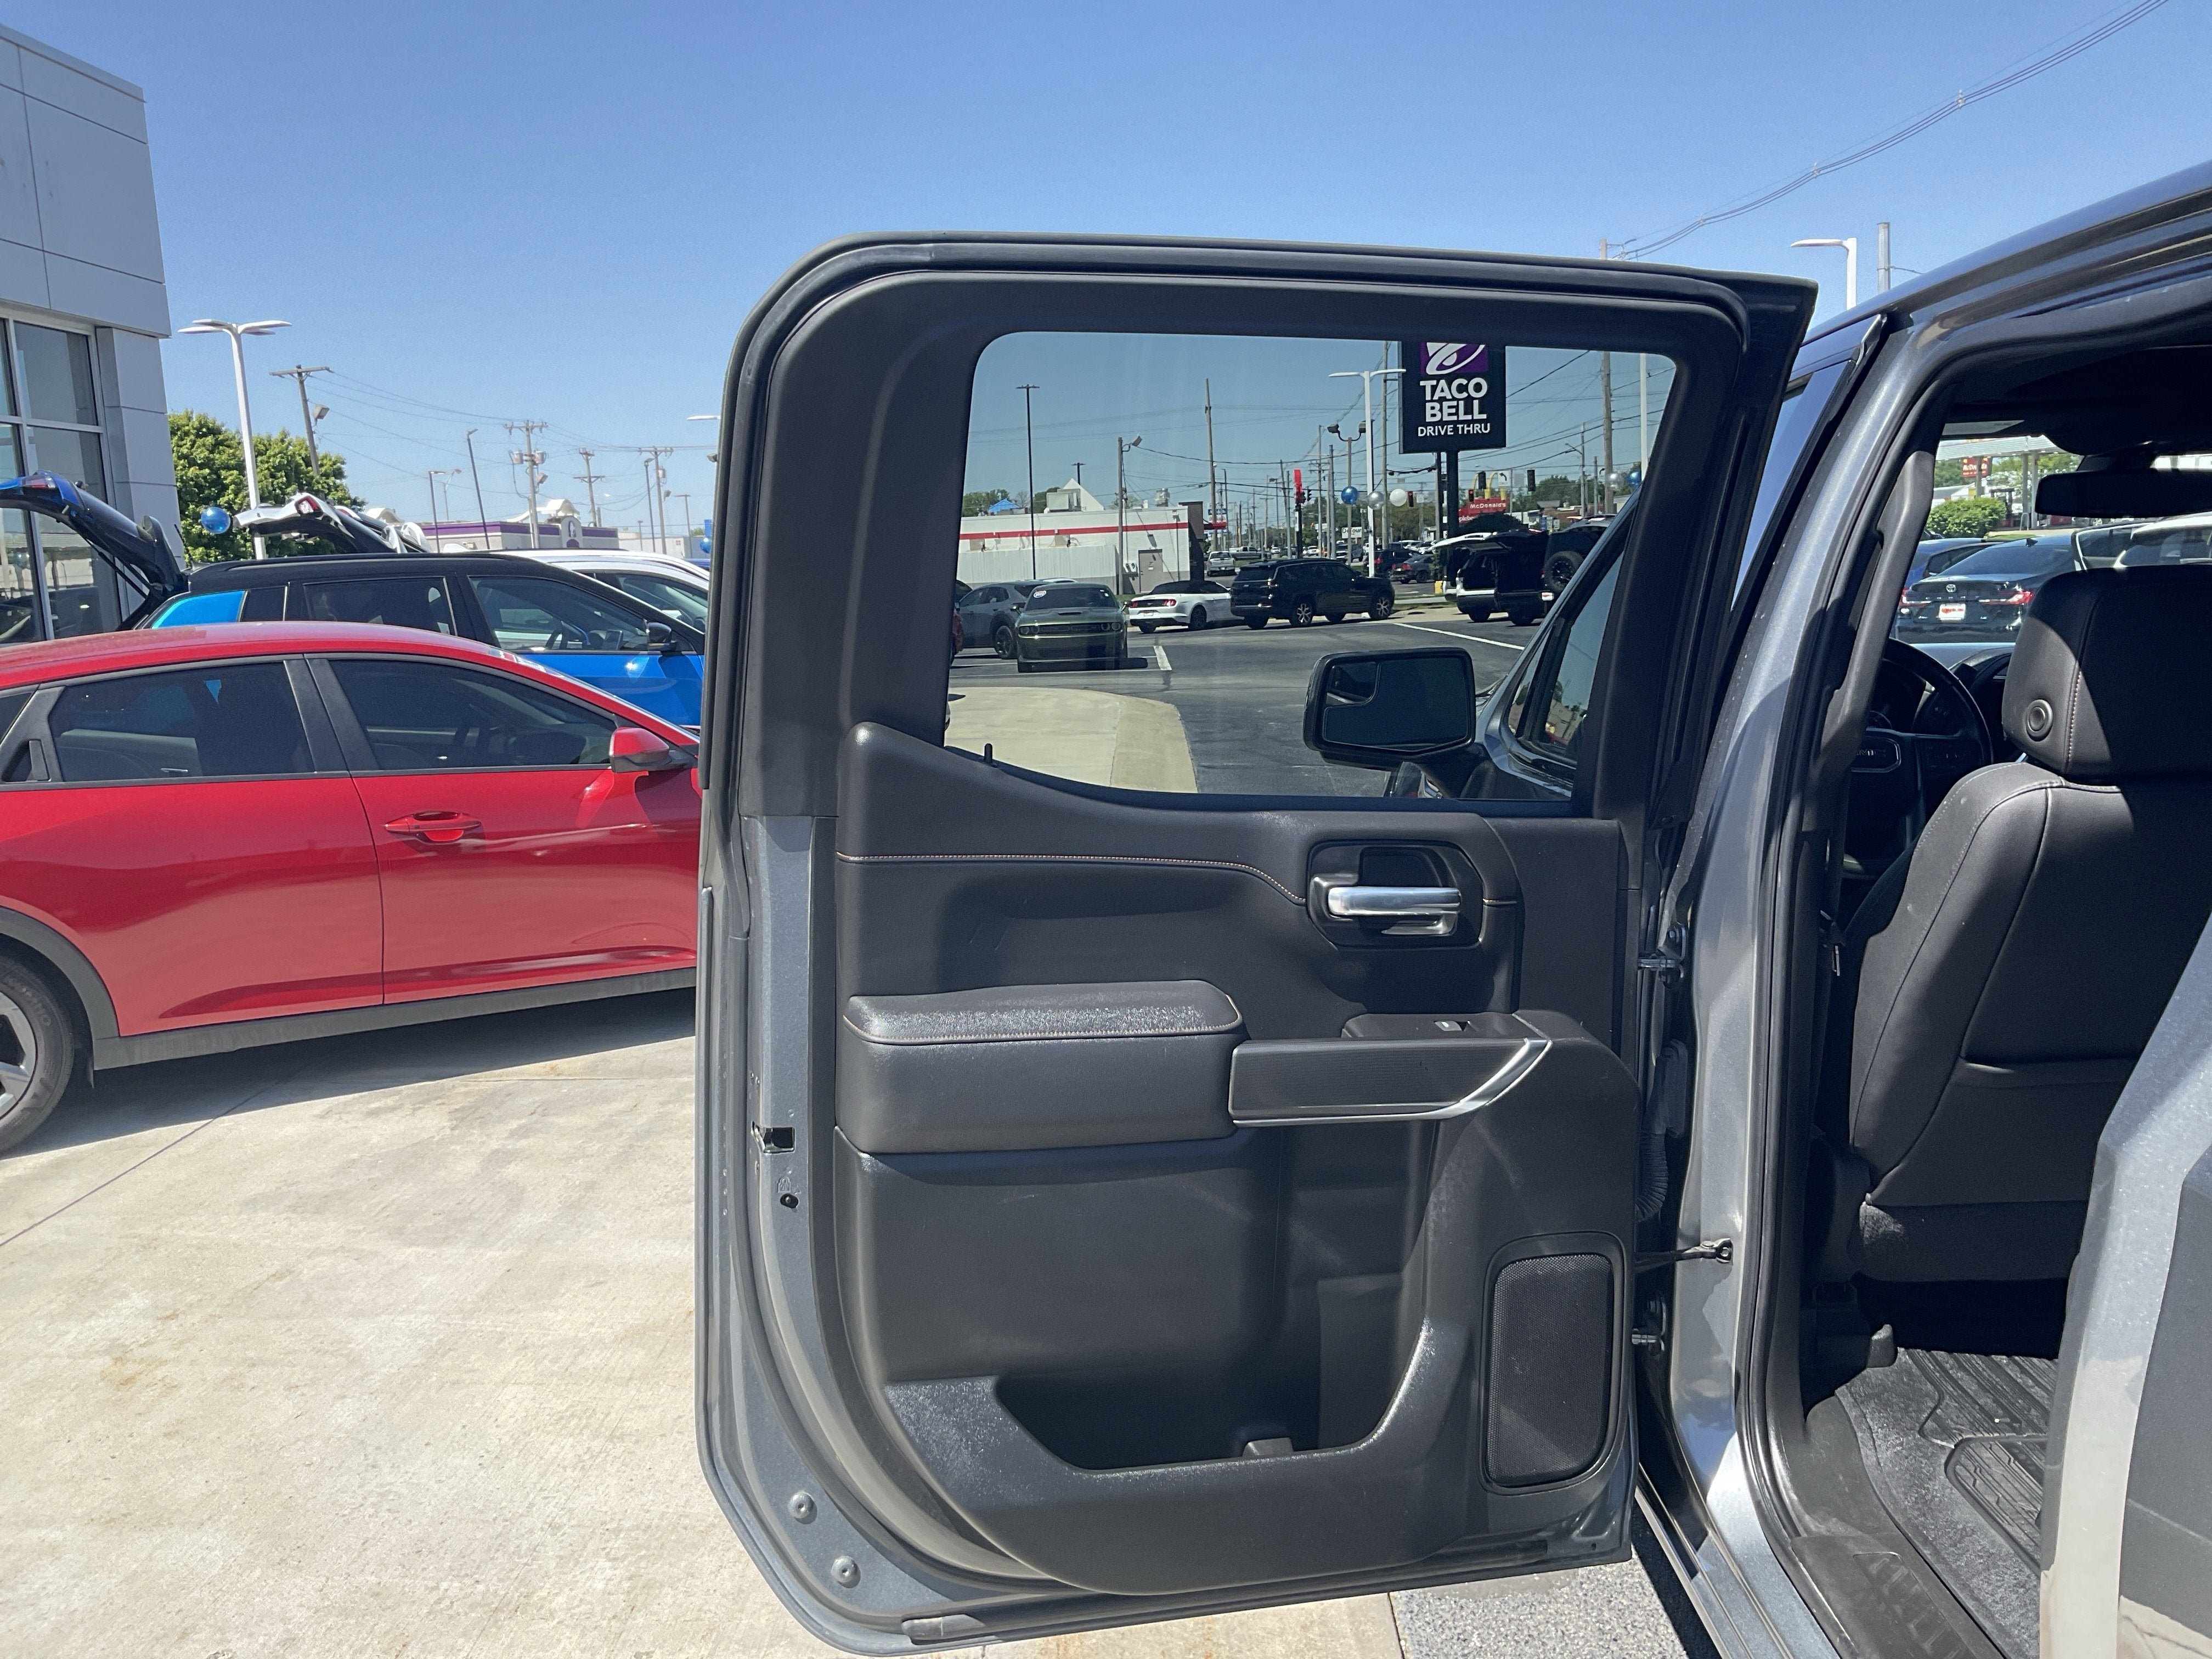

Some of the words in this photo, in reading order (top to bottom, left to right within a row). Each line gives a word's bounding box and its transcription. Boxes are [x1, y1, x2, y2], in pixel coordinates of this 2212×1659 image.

[1420, 377, 1488, 400] TACO
[1425, 399, 1487, 422] BELL
[1418, 425, 1454, 437] DRIVE
[1457, 423, 1491, 435] THRU
